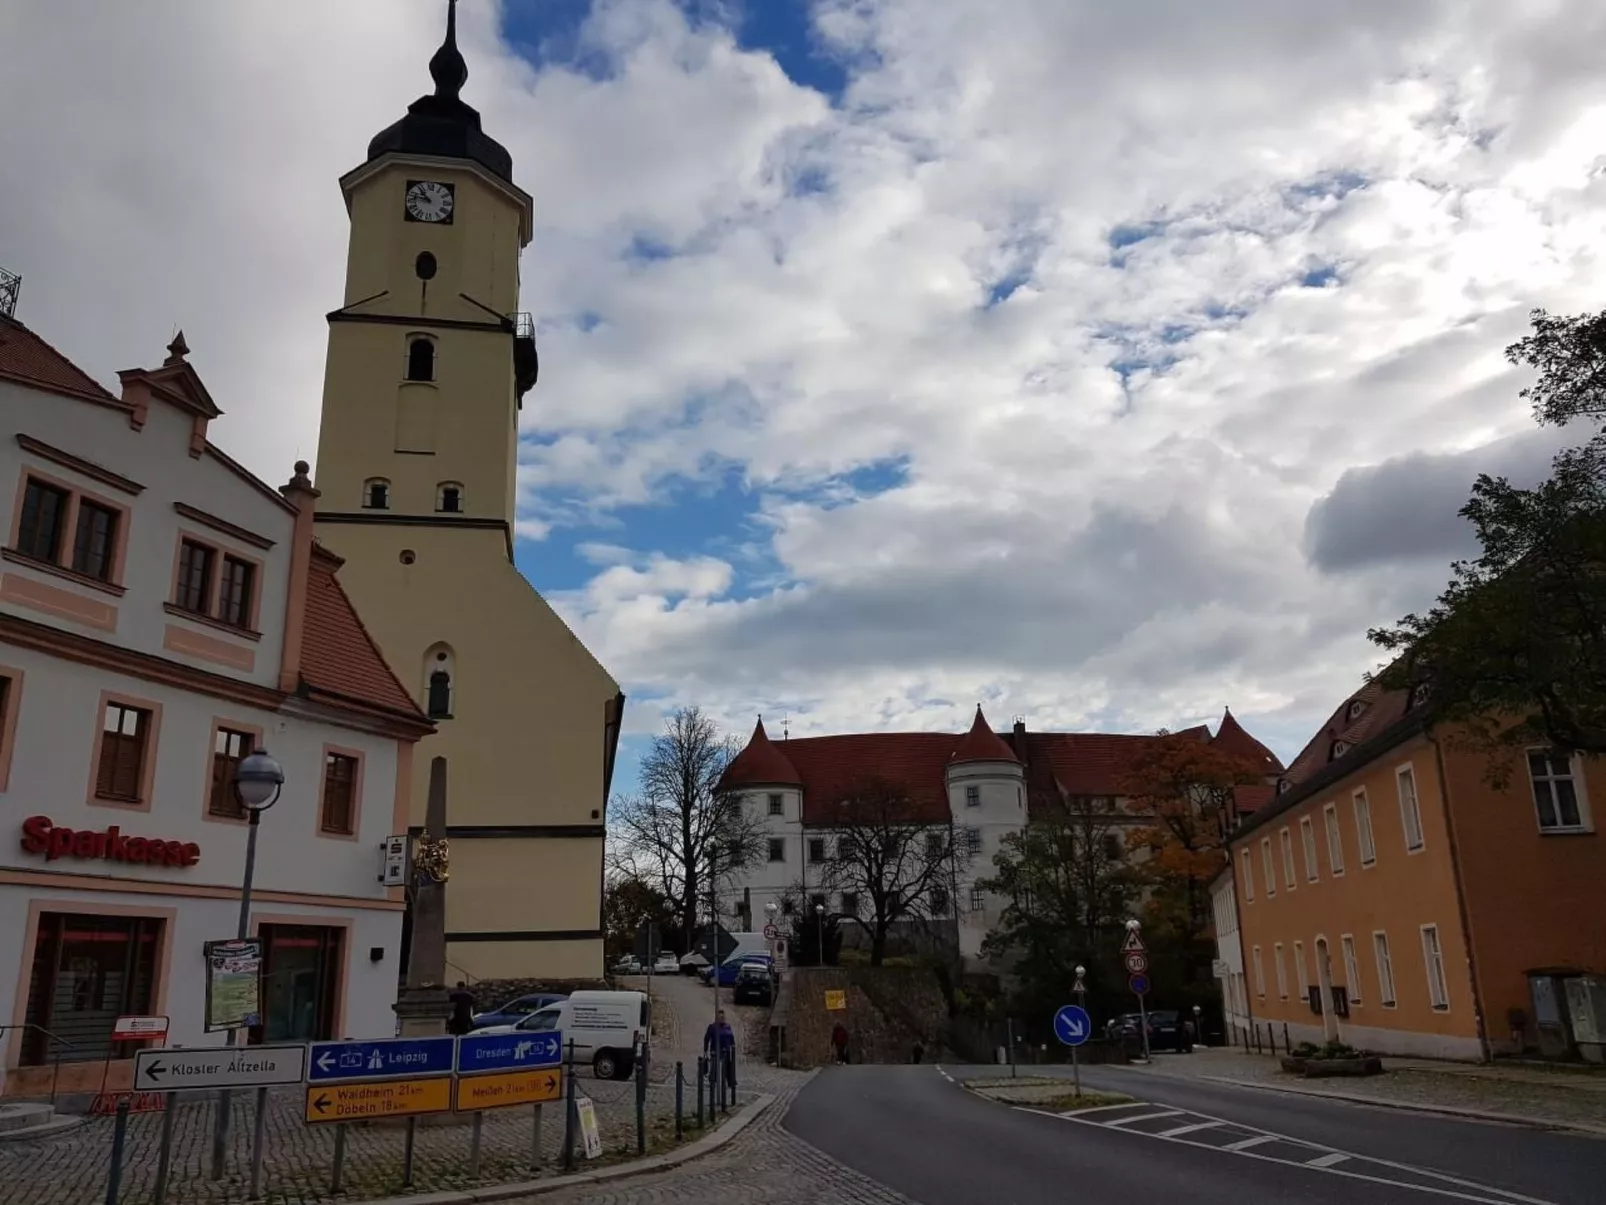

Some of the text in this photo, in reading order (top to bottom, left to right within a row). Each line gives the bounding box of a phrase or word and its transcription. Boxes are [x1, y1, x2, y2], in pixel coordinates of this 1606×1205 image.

[20, 816, 200, 866] Sparkasse
[1131, 958, 1143, 967] 30
[389, 1052, 428, 1064] Leipzig
[476, 1047, 511, 1059] Dresden
[346, 1056, 356, 1064] 14
[172, 1061, 276, 1075] Kloster Altzella
[337, 1086, 394, 1100] Waldheim
[336, 1103, 376, 1115] Döbeln
